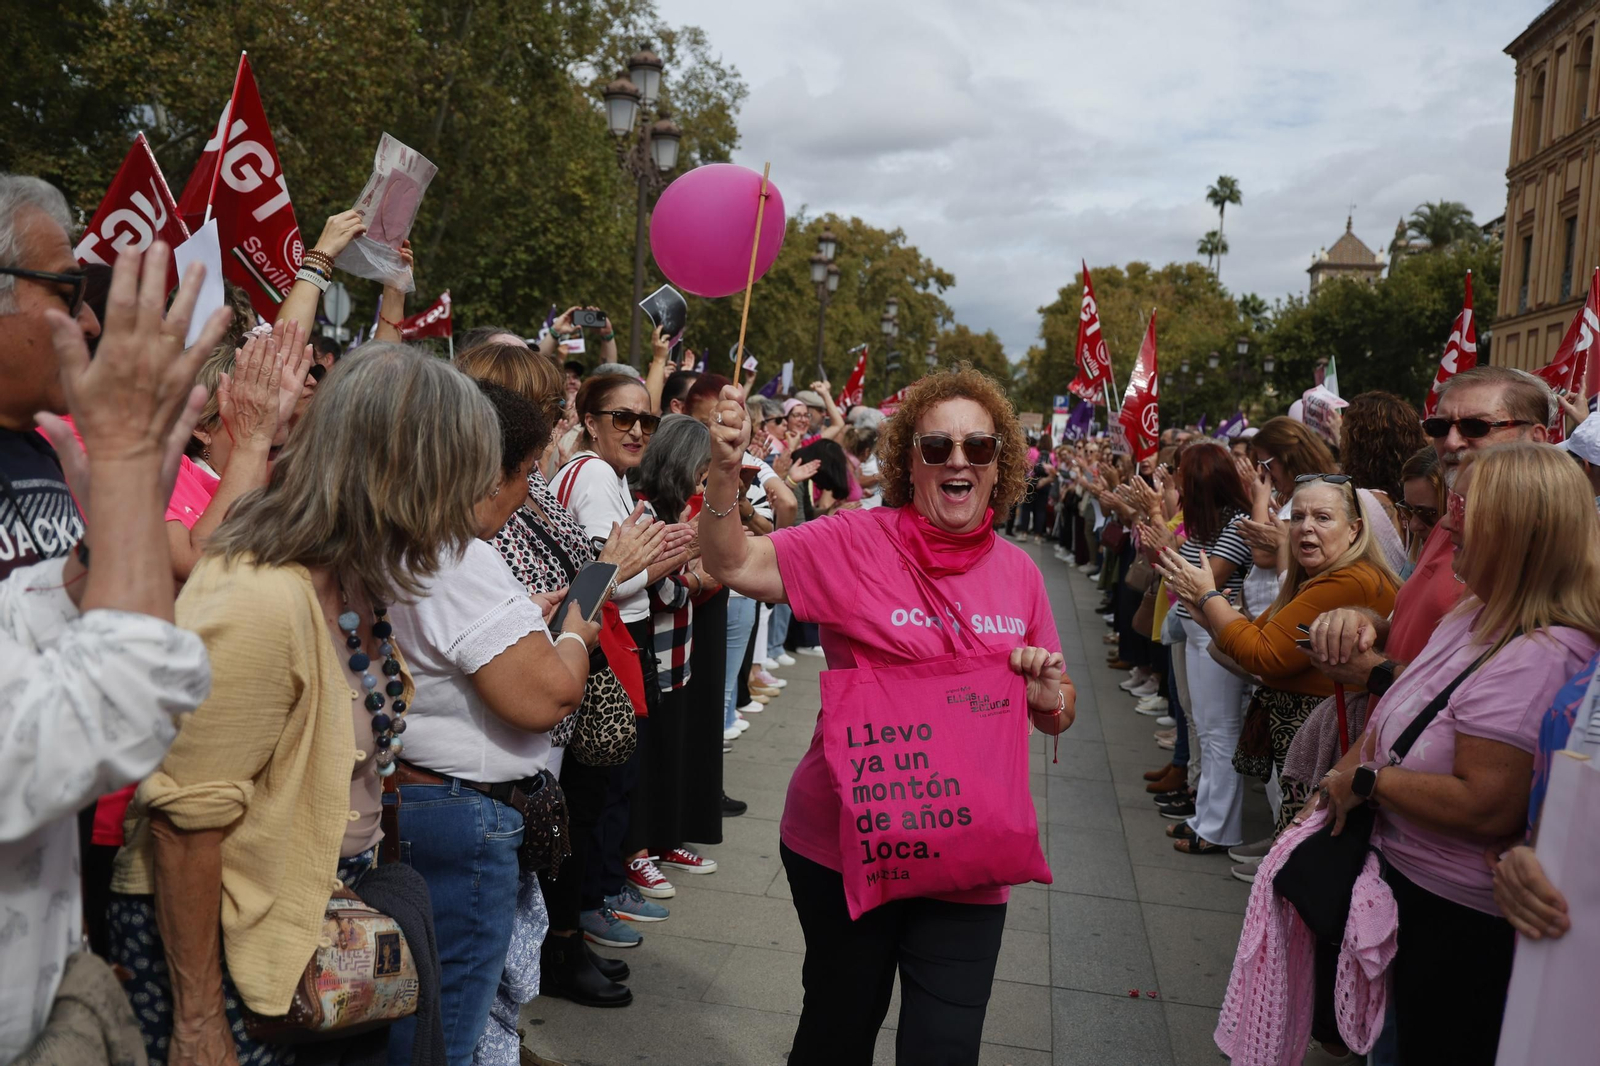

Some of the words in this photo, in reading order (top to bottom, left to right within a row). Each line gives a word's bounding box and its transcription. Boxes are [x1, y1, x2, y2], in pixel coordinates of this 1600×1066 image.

[243, 235, 293, 298] Sevilla
[1056, 396, 1066, 409] P
[971, 614, 1027, 637] SALUD
[947, 692, 977, 704] ELLAS
[979, 698, 1010, 712] CIUDAD
[846, 722, 932, 749] Llevo
[850, 754, 885, 783] ya
[894, 750, 929, 770] un
[852, 771, 961, 804] montón
[856, 808, 891, 834] de
[901, 804, 972, 830] años
[860, 839, 941, 865] loca.
